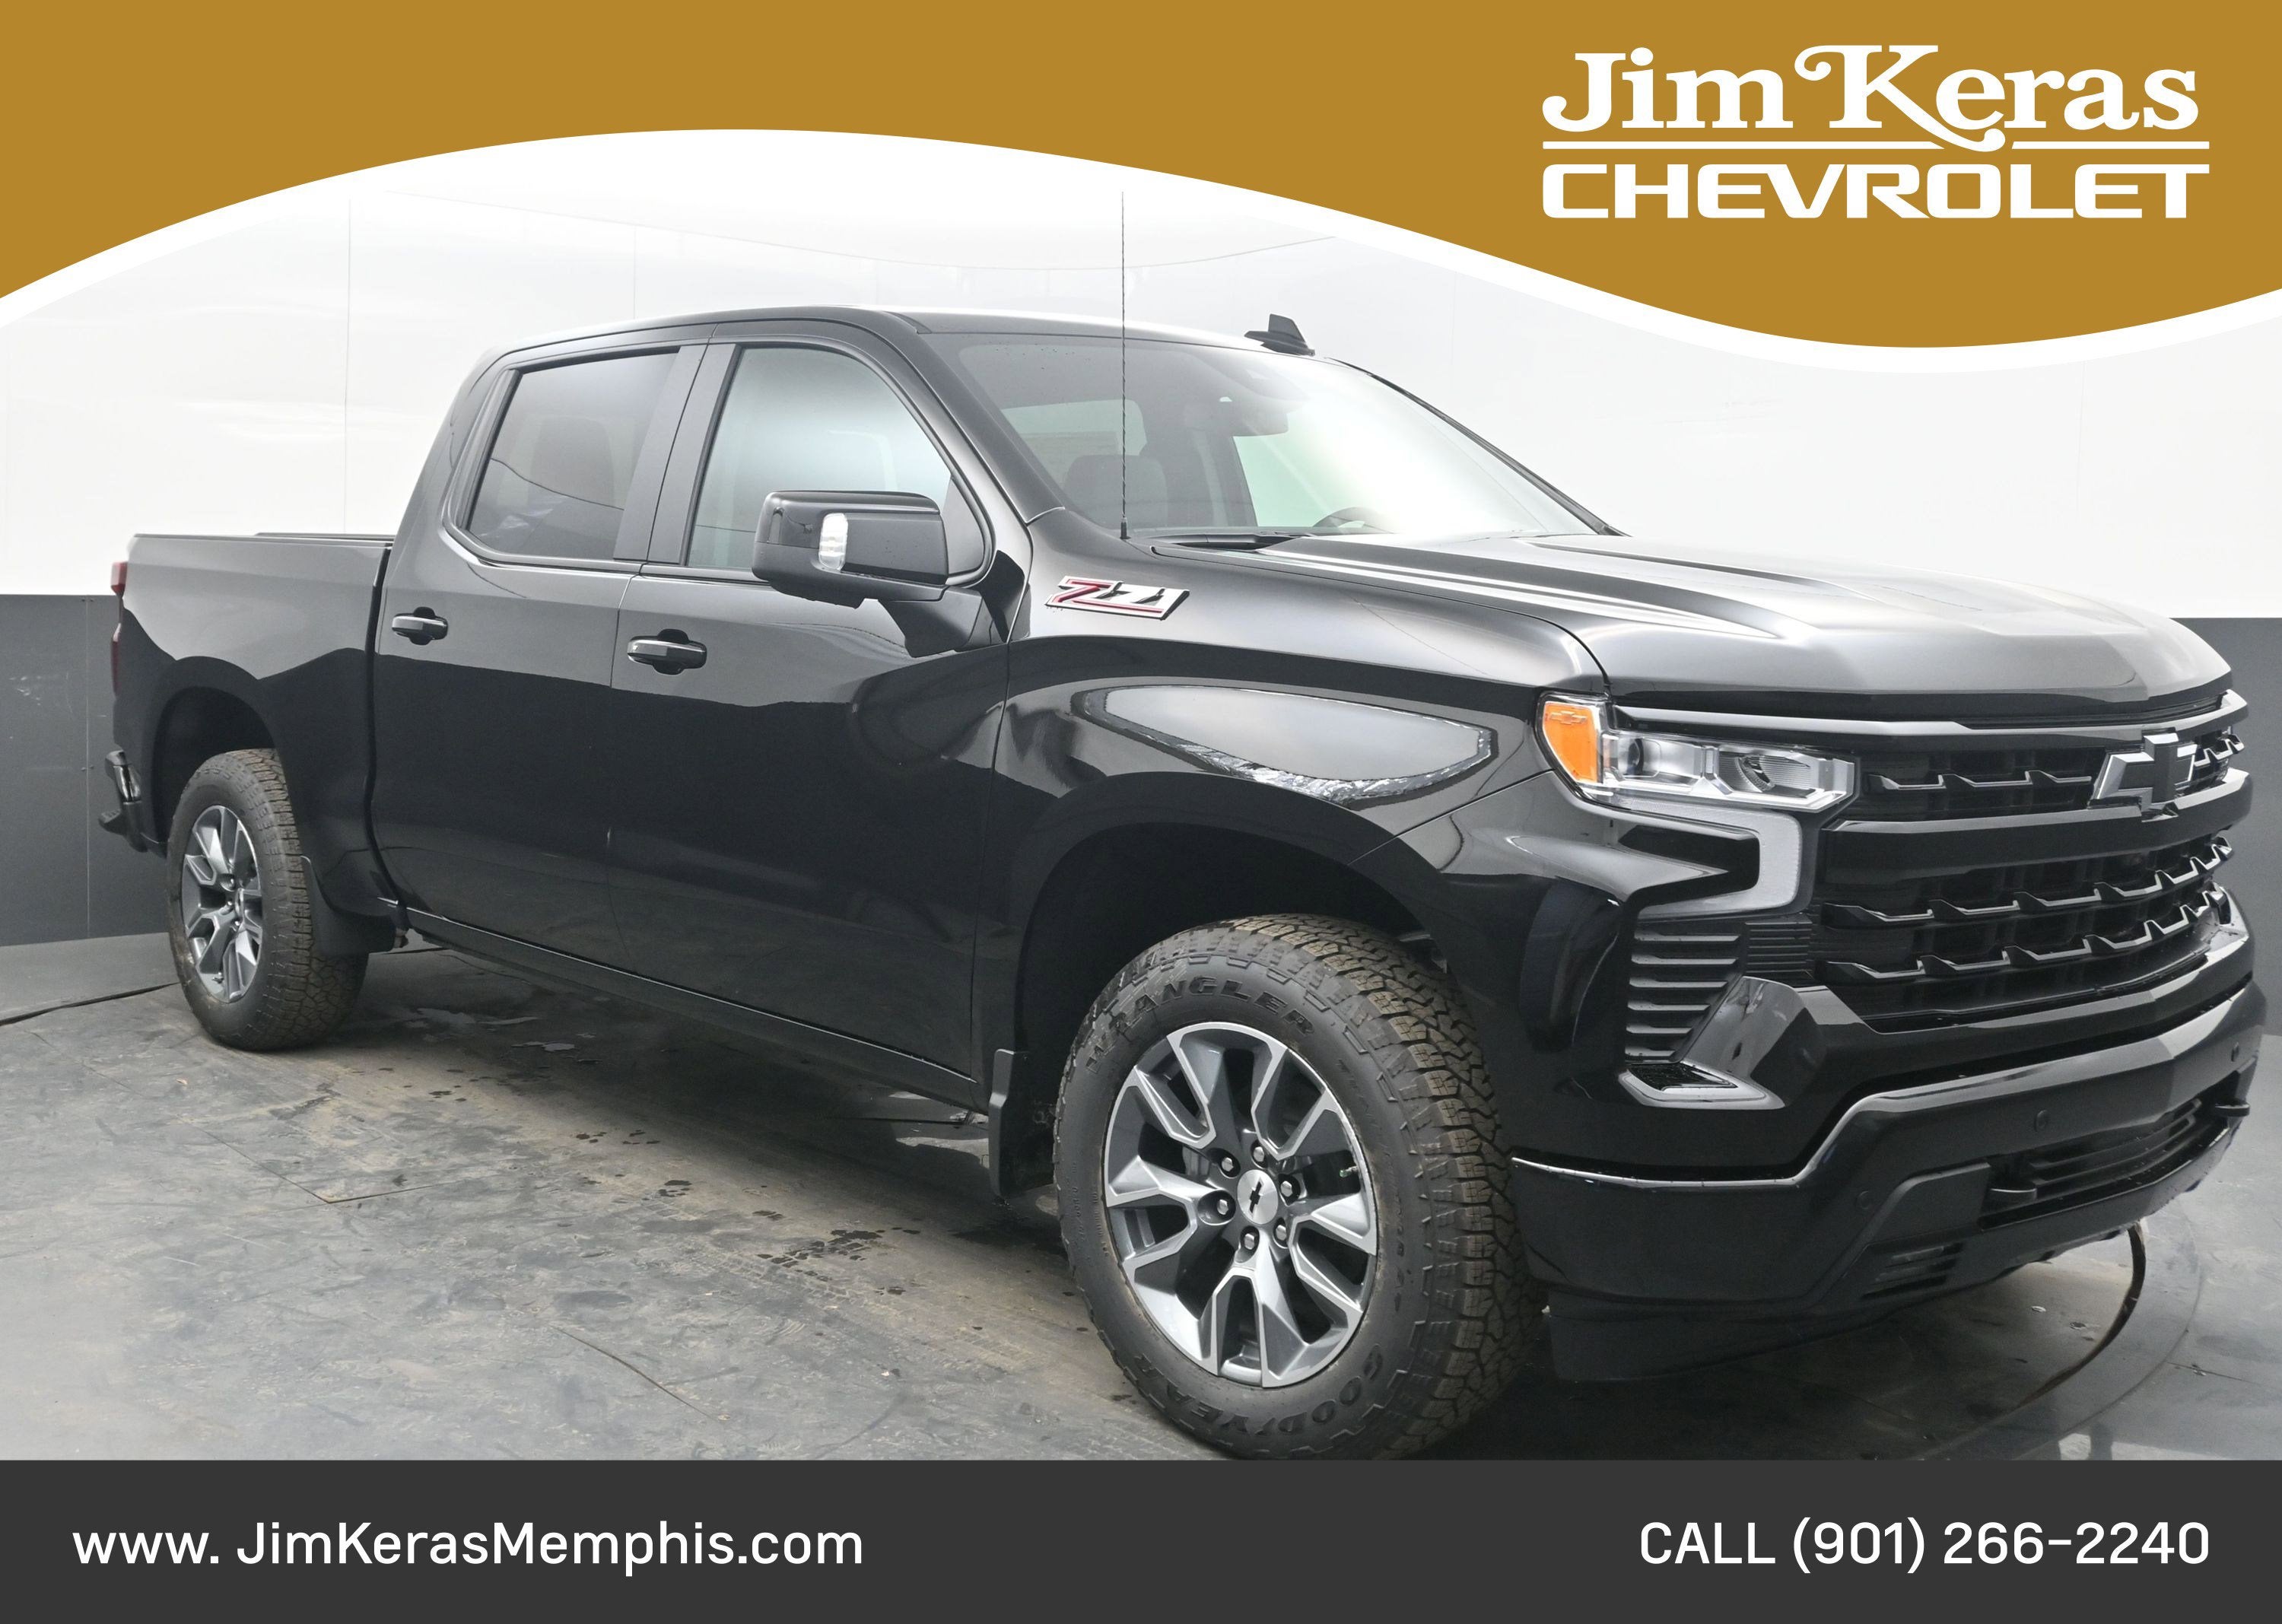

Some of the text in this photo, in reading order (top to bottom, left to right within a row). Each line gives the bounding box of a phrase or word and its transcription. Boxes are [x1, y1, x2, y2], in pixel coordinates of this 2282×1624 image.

[1044, 575, 1190, 621] Z71
[1085, 975, 1315, 1074] WRANGLER
[1133, 1343, 1384, 1437] GOODYEAR
